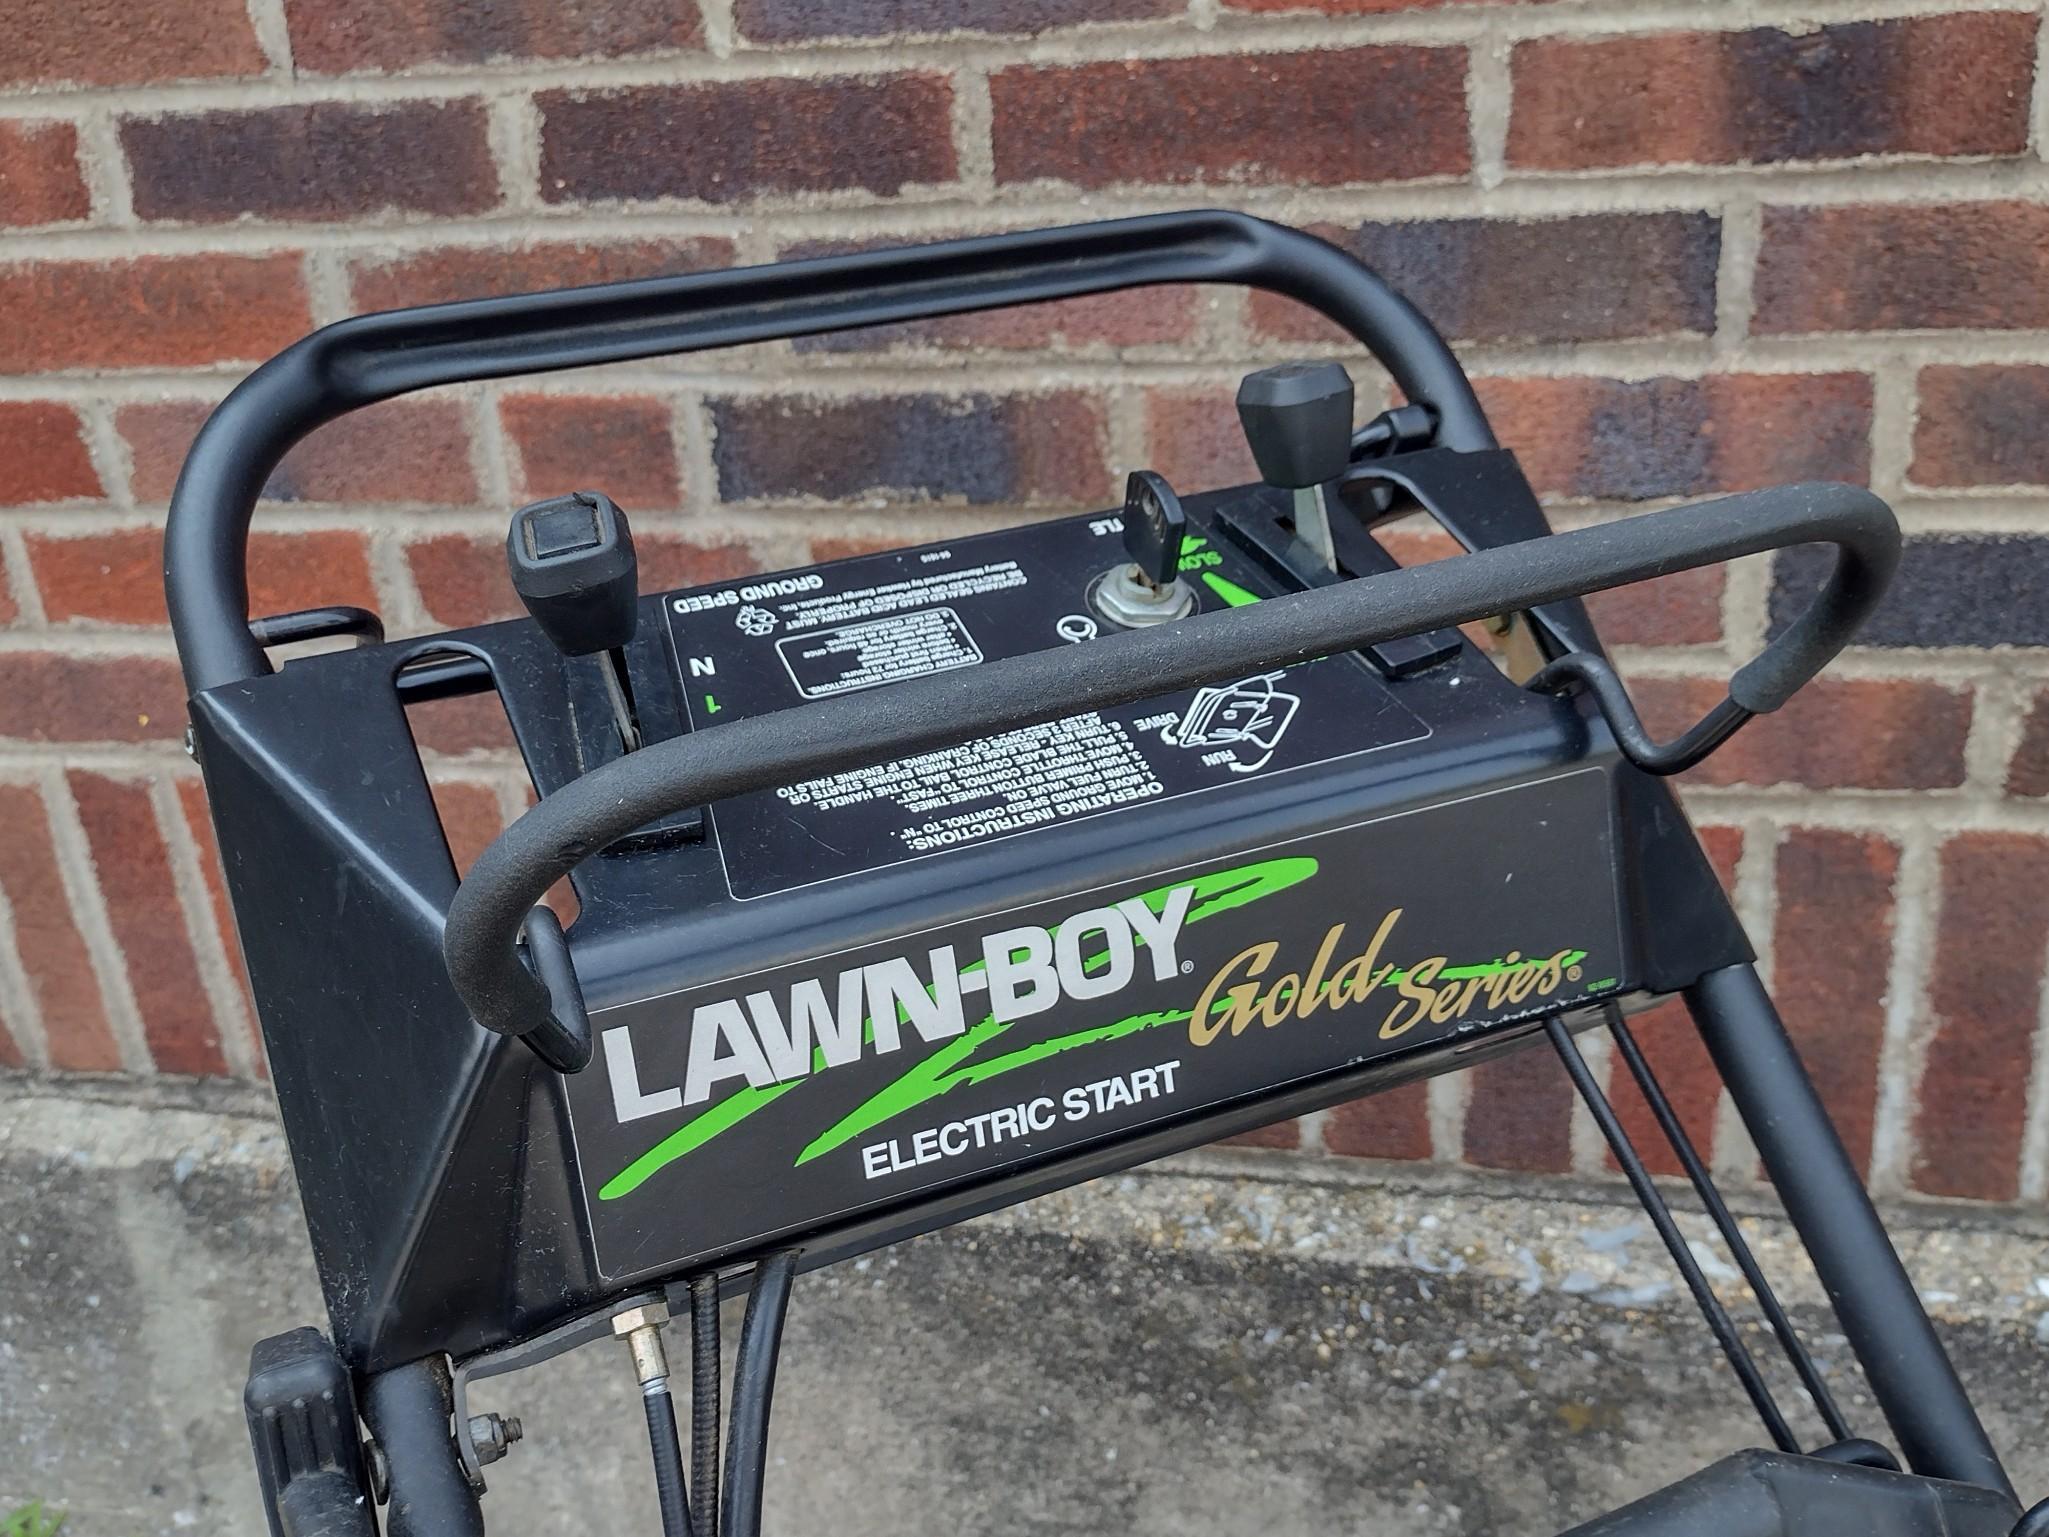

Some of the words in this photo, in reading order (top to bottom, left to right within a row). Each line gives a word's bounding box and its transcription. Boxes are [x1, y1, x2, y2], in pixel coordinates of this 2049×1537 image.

[739, 574, 823, 601] GROUND
[673, 590, 739, 613] SPEED
[689, 656, 715, 677] N
[705, 694, 721, 713] 1
[1050, 724, 1062, 735] 3
[1060, 715, 1101, 733] AFTER
[1133, 711, 1180, 731] DRIVE
[990, 727, 1052, 748] SECONDS
[1049, 731, 1075, 746] KEY
[1073, 724, 1111, 739] TURN
[971, 741, 990, 754] OF
[980, 739, 1041, 760] RELEASE
[1055, 741, 1084, 755] THE
[1080, 733, 1116, 749] PULL
[955, 752, 982, 767] KEY
[1011, 746, 1057, 765] BLADE
[1084, 743, 1123, 760] MOVE
[1201, 749, 1237, 766] RUN
[885, 761, 900, 774] IF
[913, 759, 954, 776] WHEN
[949, 757, 1013, 778] CONTROL
[1020, 752, 1087, 774] THROTTLE
[1092, 753, 1130, 770] PUSH
[833, 765, 885, 784] ENGINE
[863, 768, 914, 788] ENGINE
[918, 771, 951, 786] BAIL
[958, 767, 1021, 788] CONTROL
[1043, 761, 1094, 781] PRIMER
[1066, 771, 1103, 787] FUEL
[1100, 763, 1139, 779] TURN
[795, 776, 834, 793] FAILS
[810, 780, 863, 800] STARTS
[872, 783, 902, 798] THE
[900, 778, 921, 791] TO
[939, 781, 961, 793] TO
[991, 773, 1045, 793] BUTTON
[1026, 779, 1070, 797] VALVE
[1104, 773, 1144, 790] MOVE
[775, 785, 797, 798] TO
[788, 792, 811, 805] OR
[947, 785, 994, 804] THREE
[1050, 782, 1106, 803] GROUND
[1055, 781, 1163, 815] OPERATING
[1005, 795, 1050, 814] SPEED
[941, 806, 1005, 828] CONTROL
[906, 807, 1055, 850] INSTRUCTIONS:
[922, 820, 944, 834] TO
[1188, 907, 1403, 1047] Gold
[1378, 948, 1573, 1040] Series
[861, 1096, 1062, 1180] ELECTRIC
[1061, 1059, 1182, 1125] START
